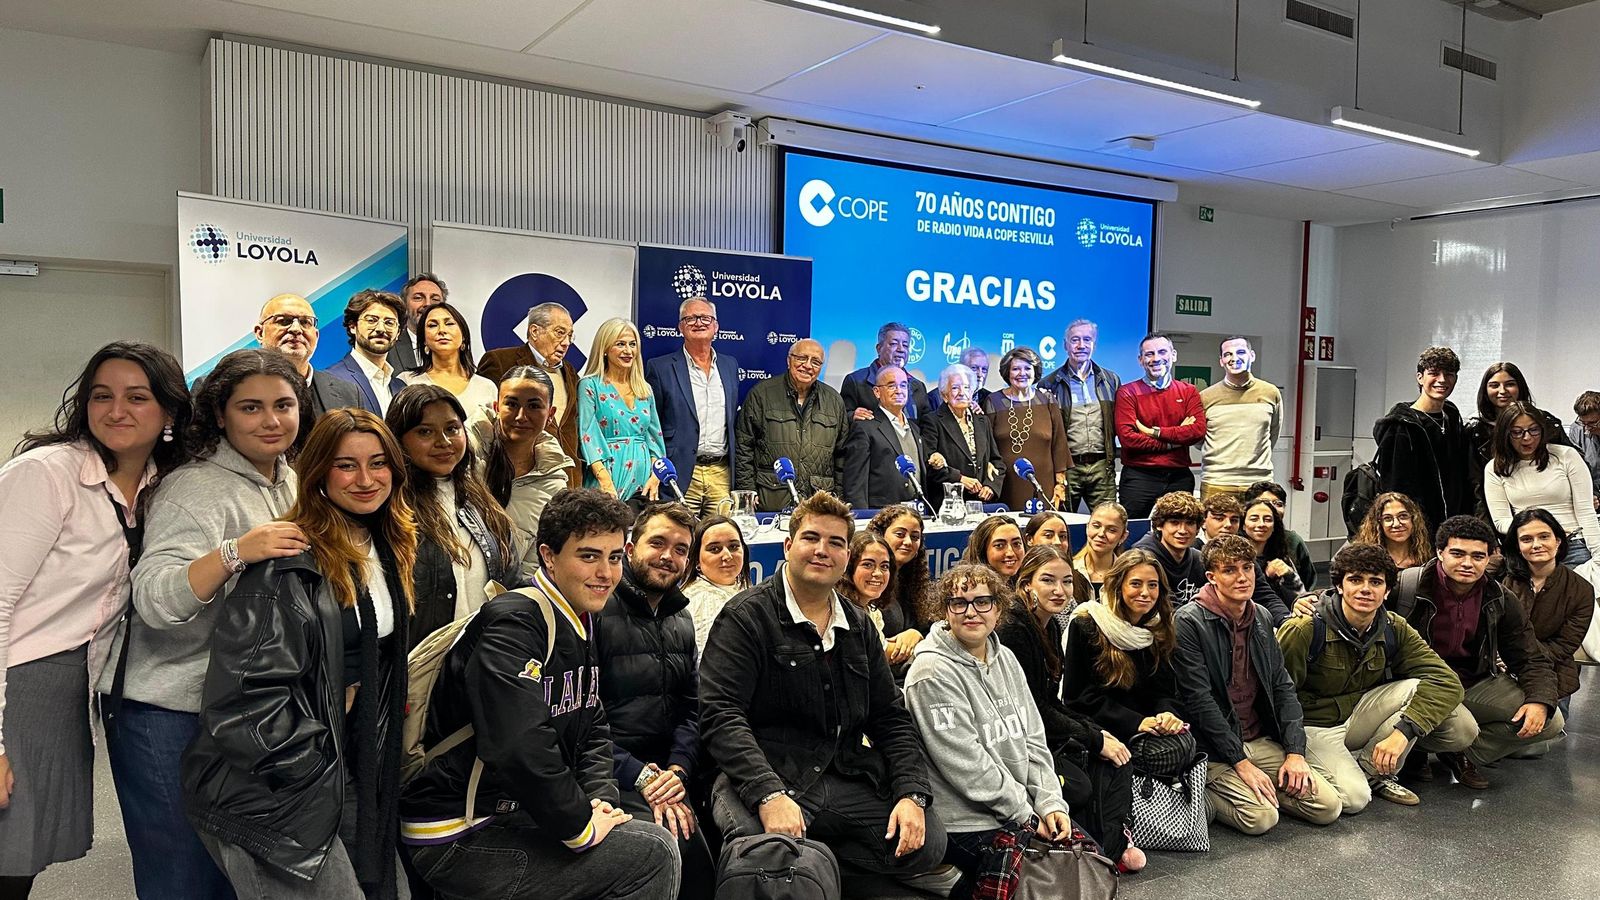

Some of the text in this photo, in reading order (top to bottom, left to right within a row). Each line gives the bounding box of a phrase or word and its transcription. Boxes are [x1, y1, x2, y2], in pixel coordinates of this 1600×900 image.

[838, 196, 889, 222] COPE
[915, 191, 1056, 228] 70 AÑOS CONTIGO
[917, 219, 1055, 246] DE RADIO VIDA A COPE SEVILLA
[1100, 223, 1130, 233] Universidad
[236, 231, 292, 246] Universidad
[1100, 231, 1143, 247] LOYOLA
[237, 242, 319, 266] LOYOLA
[712, 271, 760, 283] Universidad
[712, 282, 782, 301] LOYOLA
[905, 269, 1056, 311] GRACIAS
[1178, 299, 1209, 313] SALIDA
[719, 333, 745, 341] LOYOLA
[930, 707, 957, 731] LY
